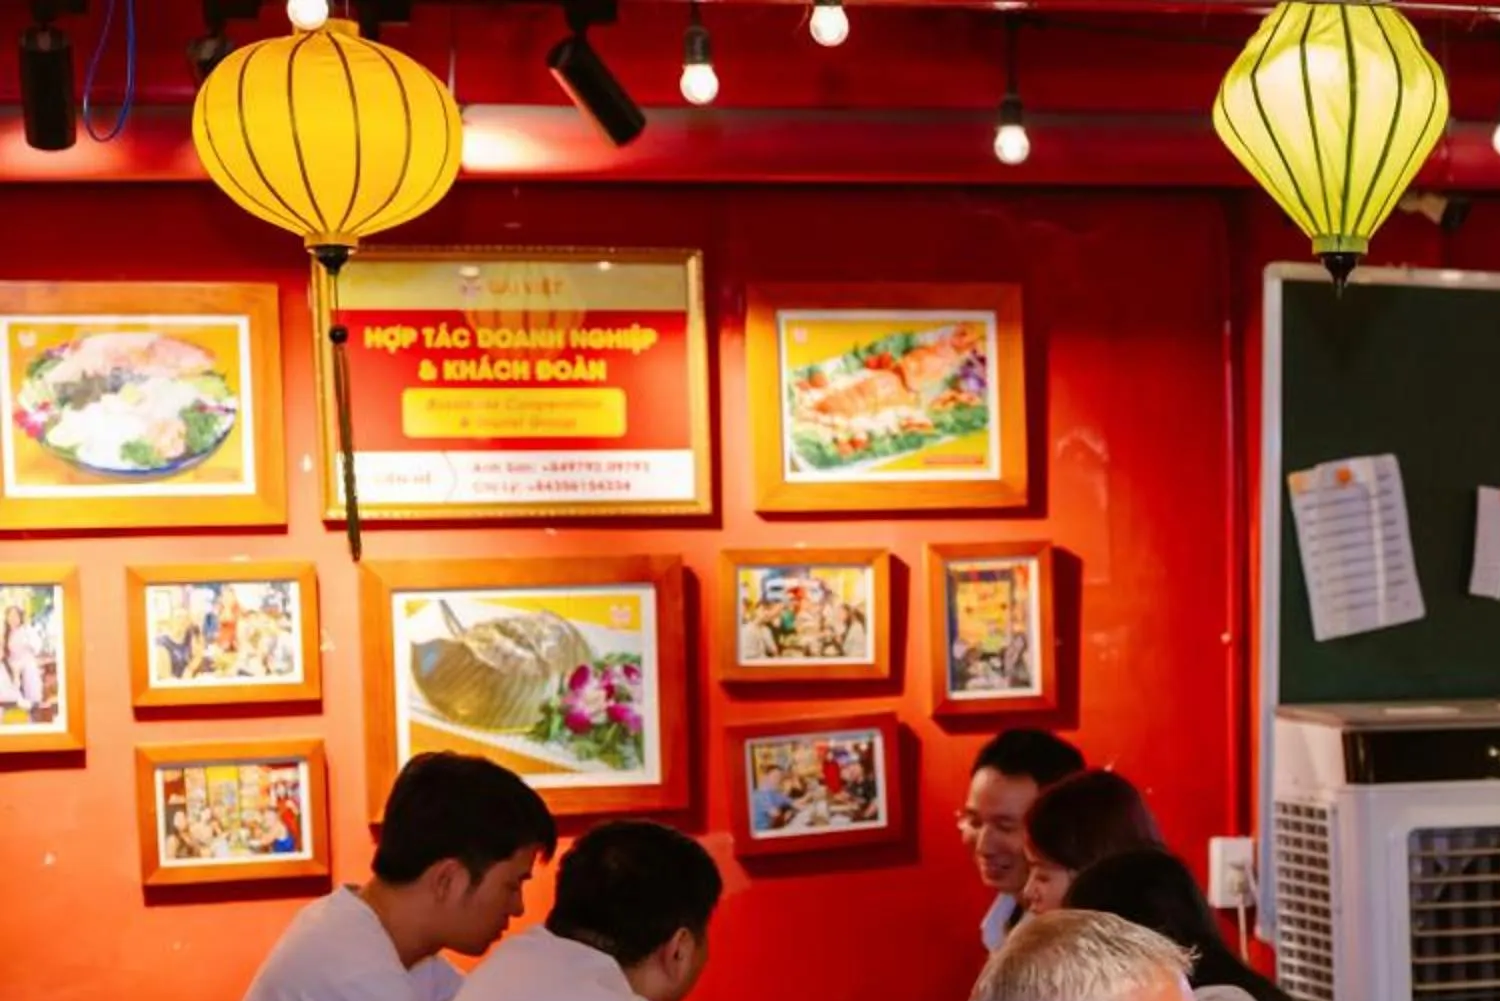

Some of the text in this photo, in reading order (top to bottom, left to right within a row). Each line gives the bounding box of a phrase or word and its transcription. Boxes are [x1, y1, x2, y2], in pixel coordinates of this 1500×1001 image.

[364, 321, 658, 356] HỢP TÁC DOANH NGHIỆP
[418, 354, 607, 381] & KHÁCH ĐOÀN
